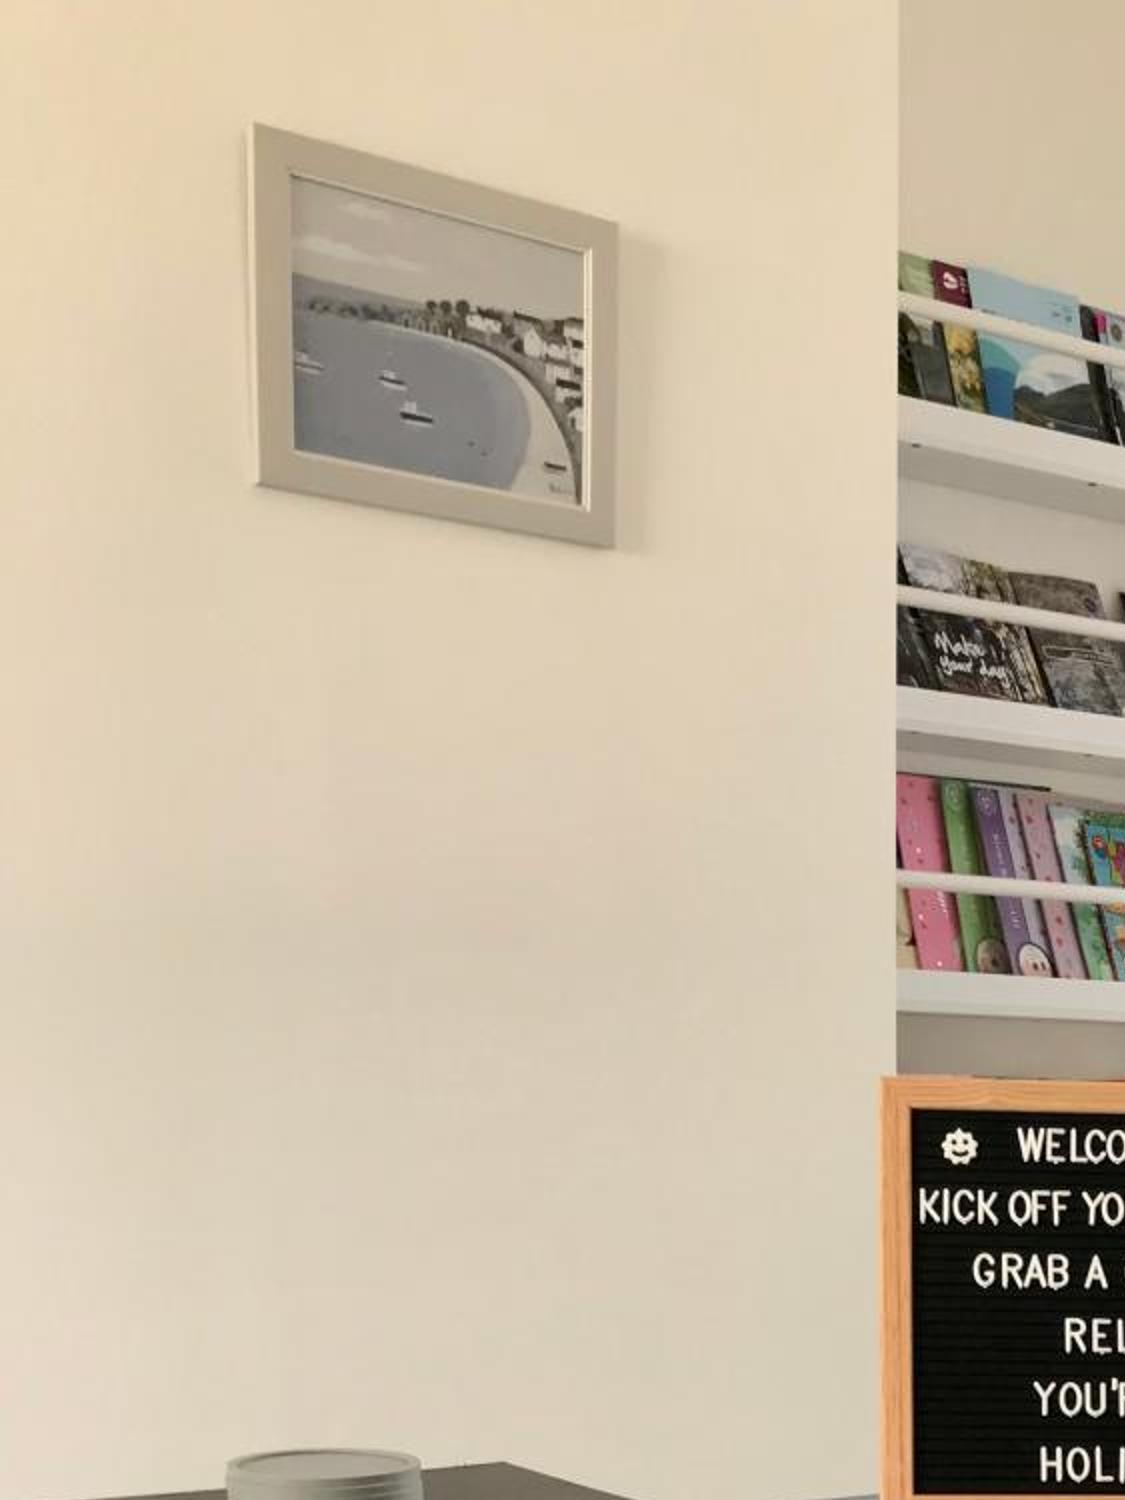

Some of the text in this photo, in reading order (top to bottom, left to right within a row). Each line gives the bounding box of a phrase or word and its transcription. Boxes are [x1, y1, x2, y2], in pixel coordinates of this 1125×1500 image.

[920, 1188, 998, 1225] KICK
[1008, 1190, 1071, 1226] OFF
[973, 1253, 1069, 1290] GRAB
[1084, 1255, 1108, 1289] A
